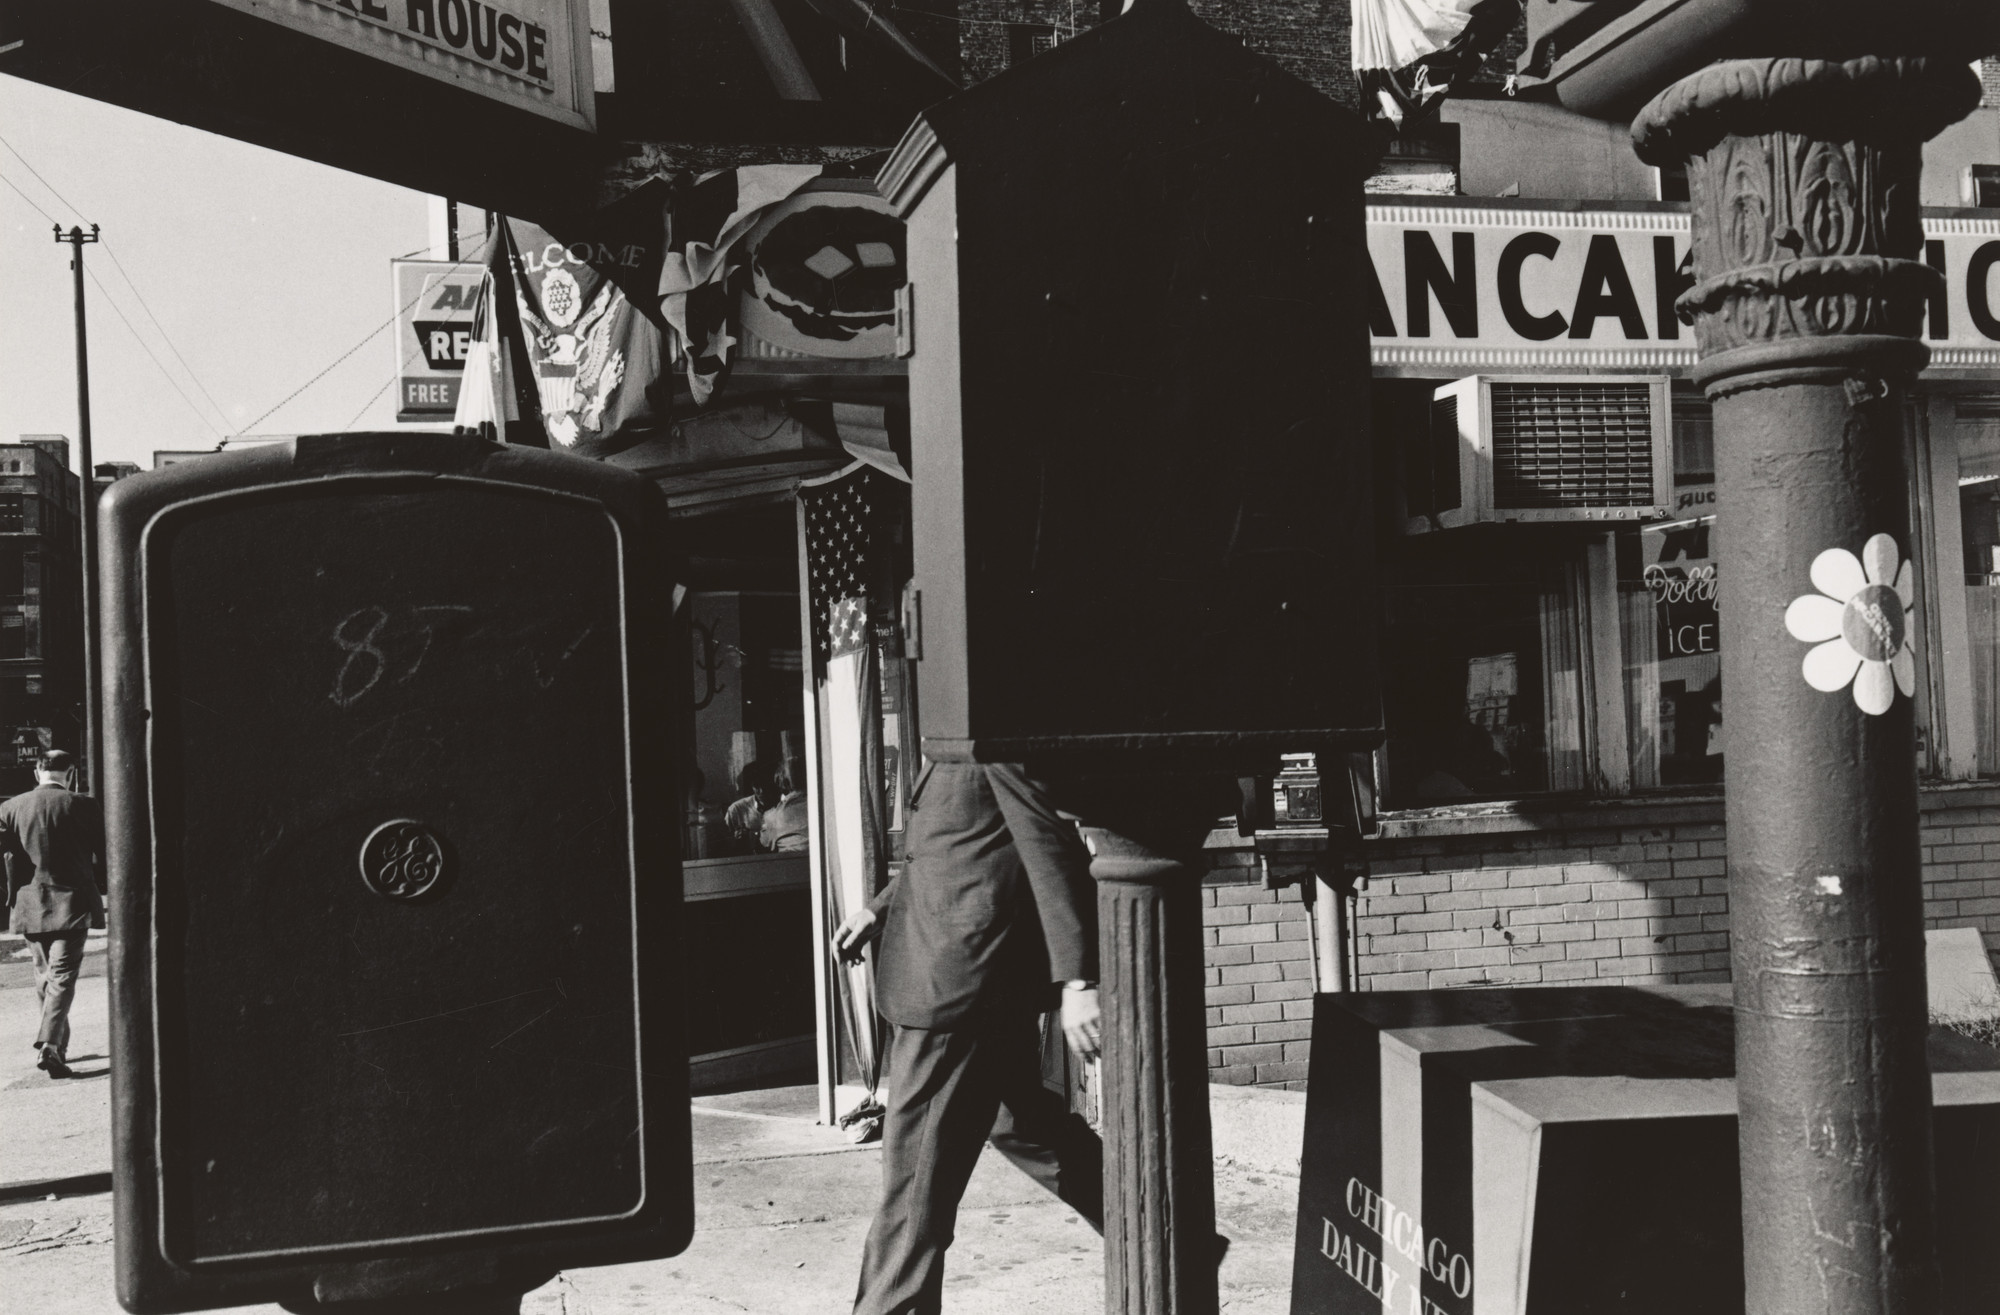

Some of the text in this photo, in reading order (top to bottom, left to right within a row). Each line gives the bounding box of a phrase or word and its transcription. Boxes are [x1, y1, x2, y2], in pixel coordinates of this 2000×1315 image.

[408, 0, 548, 81] HOUSE
[407, 384, 449, 404] FREE
[1668, 624, 1714, 654] ICE
[1320, 1216, 1400, 1309] DAILY
[1346, 1176, 1471, 1299] CHICAGO
